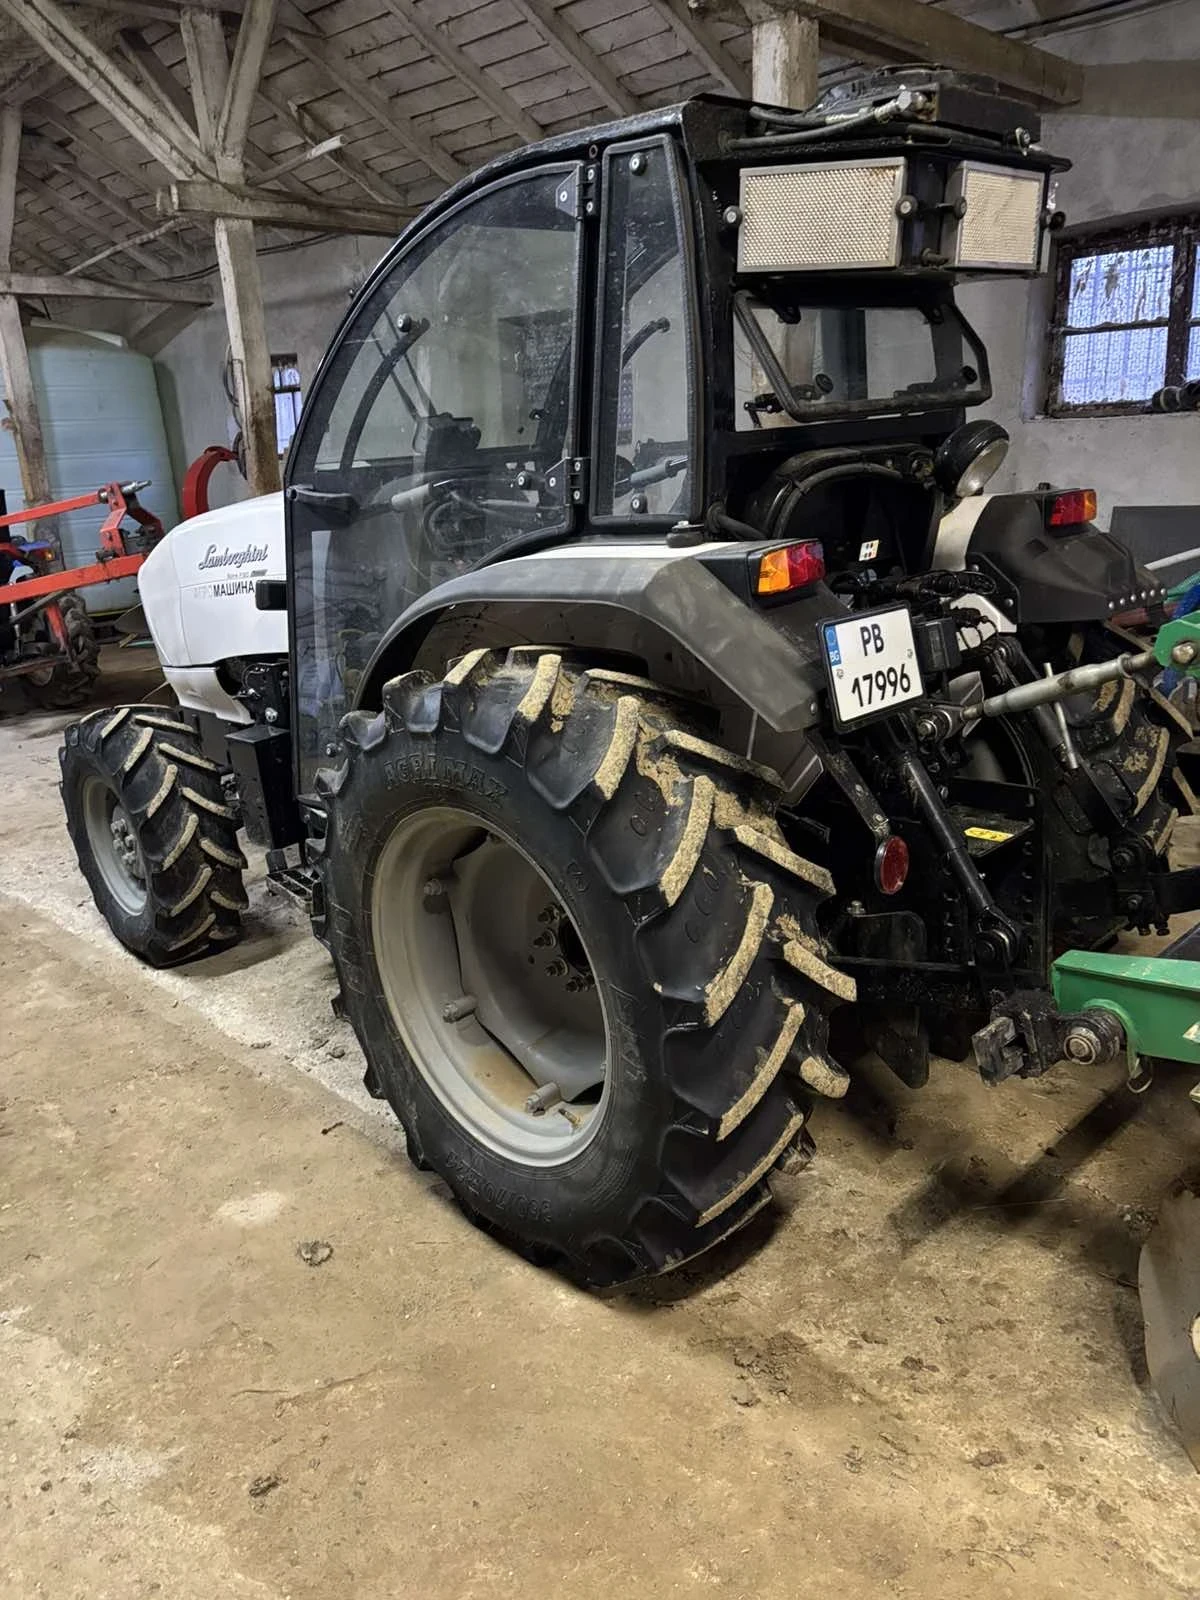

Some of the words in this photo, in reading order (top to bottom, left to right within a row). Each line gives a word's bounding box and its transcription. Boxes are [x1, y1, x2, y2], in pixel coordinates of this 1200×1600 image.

[198, 544, 269, 570] Lamborghini
[860, 623, 885, 656] PB
[851, 663, 911, 707] 17996
